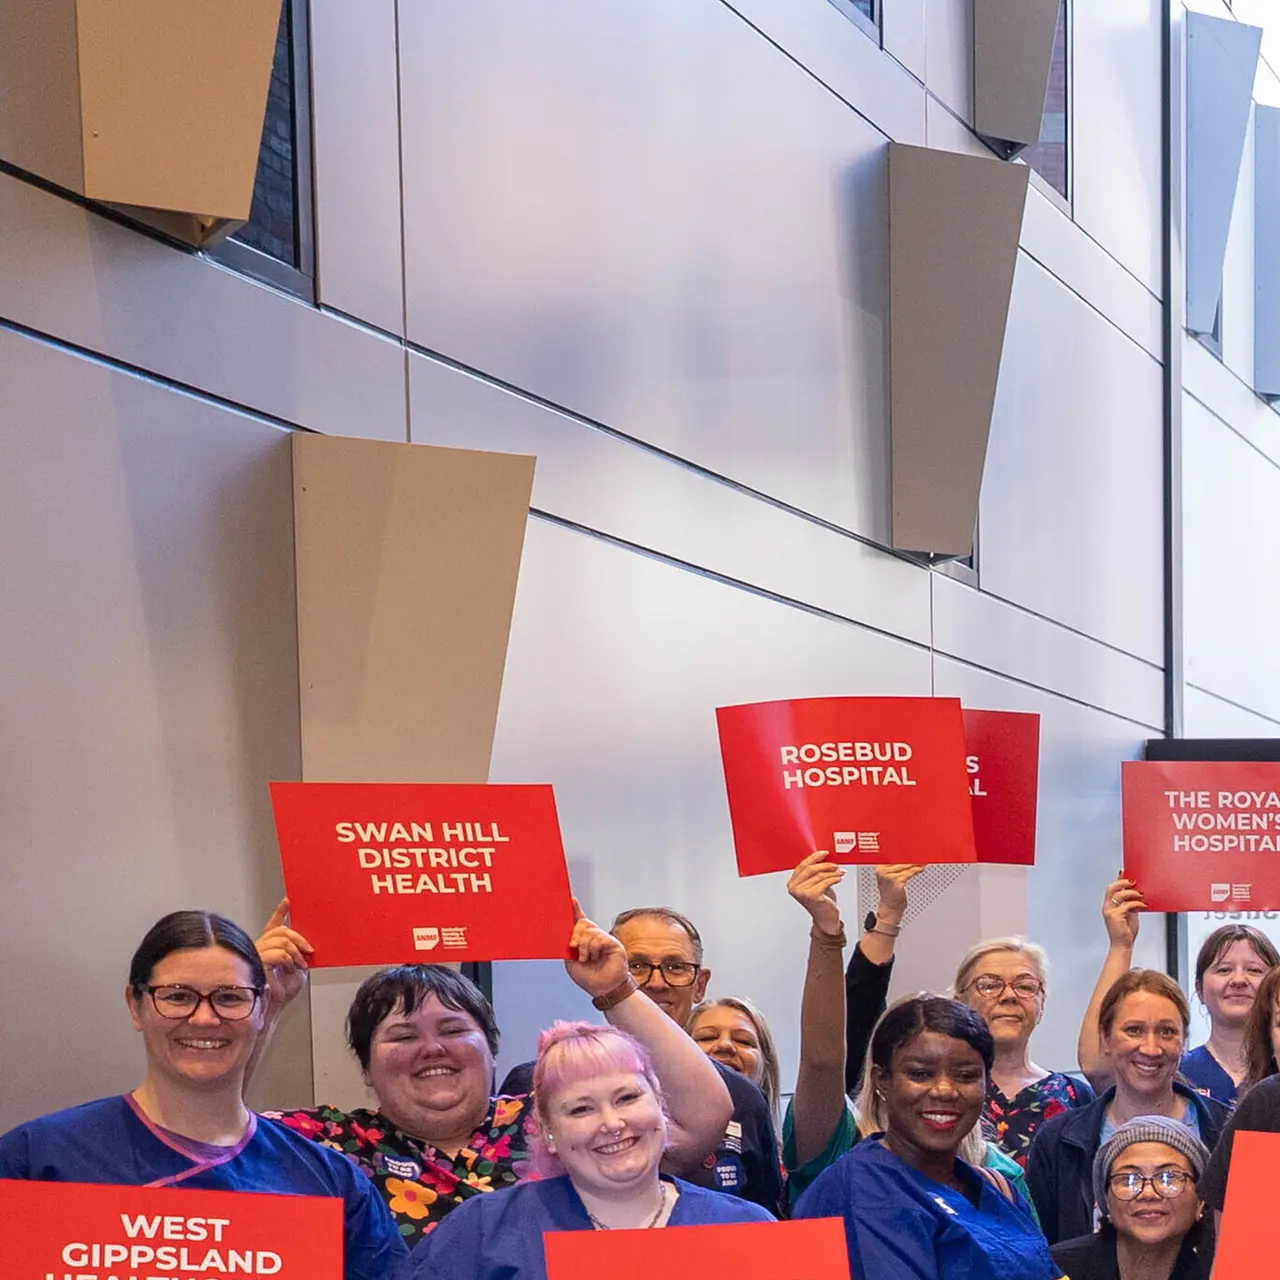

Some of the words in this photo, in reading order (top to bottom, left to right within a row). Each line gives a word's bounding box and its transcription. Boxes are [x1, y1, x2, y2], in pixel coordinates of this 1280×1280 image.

[779, 742, 913, 766] ROSEBUD
[782, 766, 917, 790] HOSPITAL
[1163, 790, 1212, 809] THE
[335, 822, 434, 843] SWAN
[441, 822, 510, 842] HILL
[357, 847, 496, 869] DISTRICT
[370, 872, 493, 895] HEALTH
[120, 1213, 230, 1242] WEST
[61, 1242, 283, 1275] GIPPSLAND
